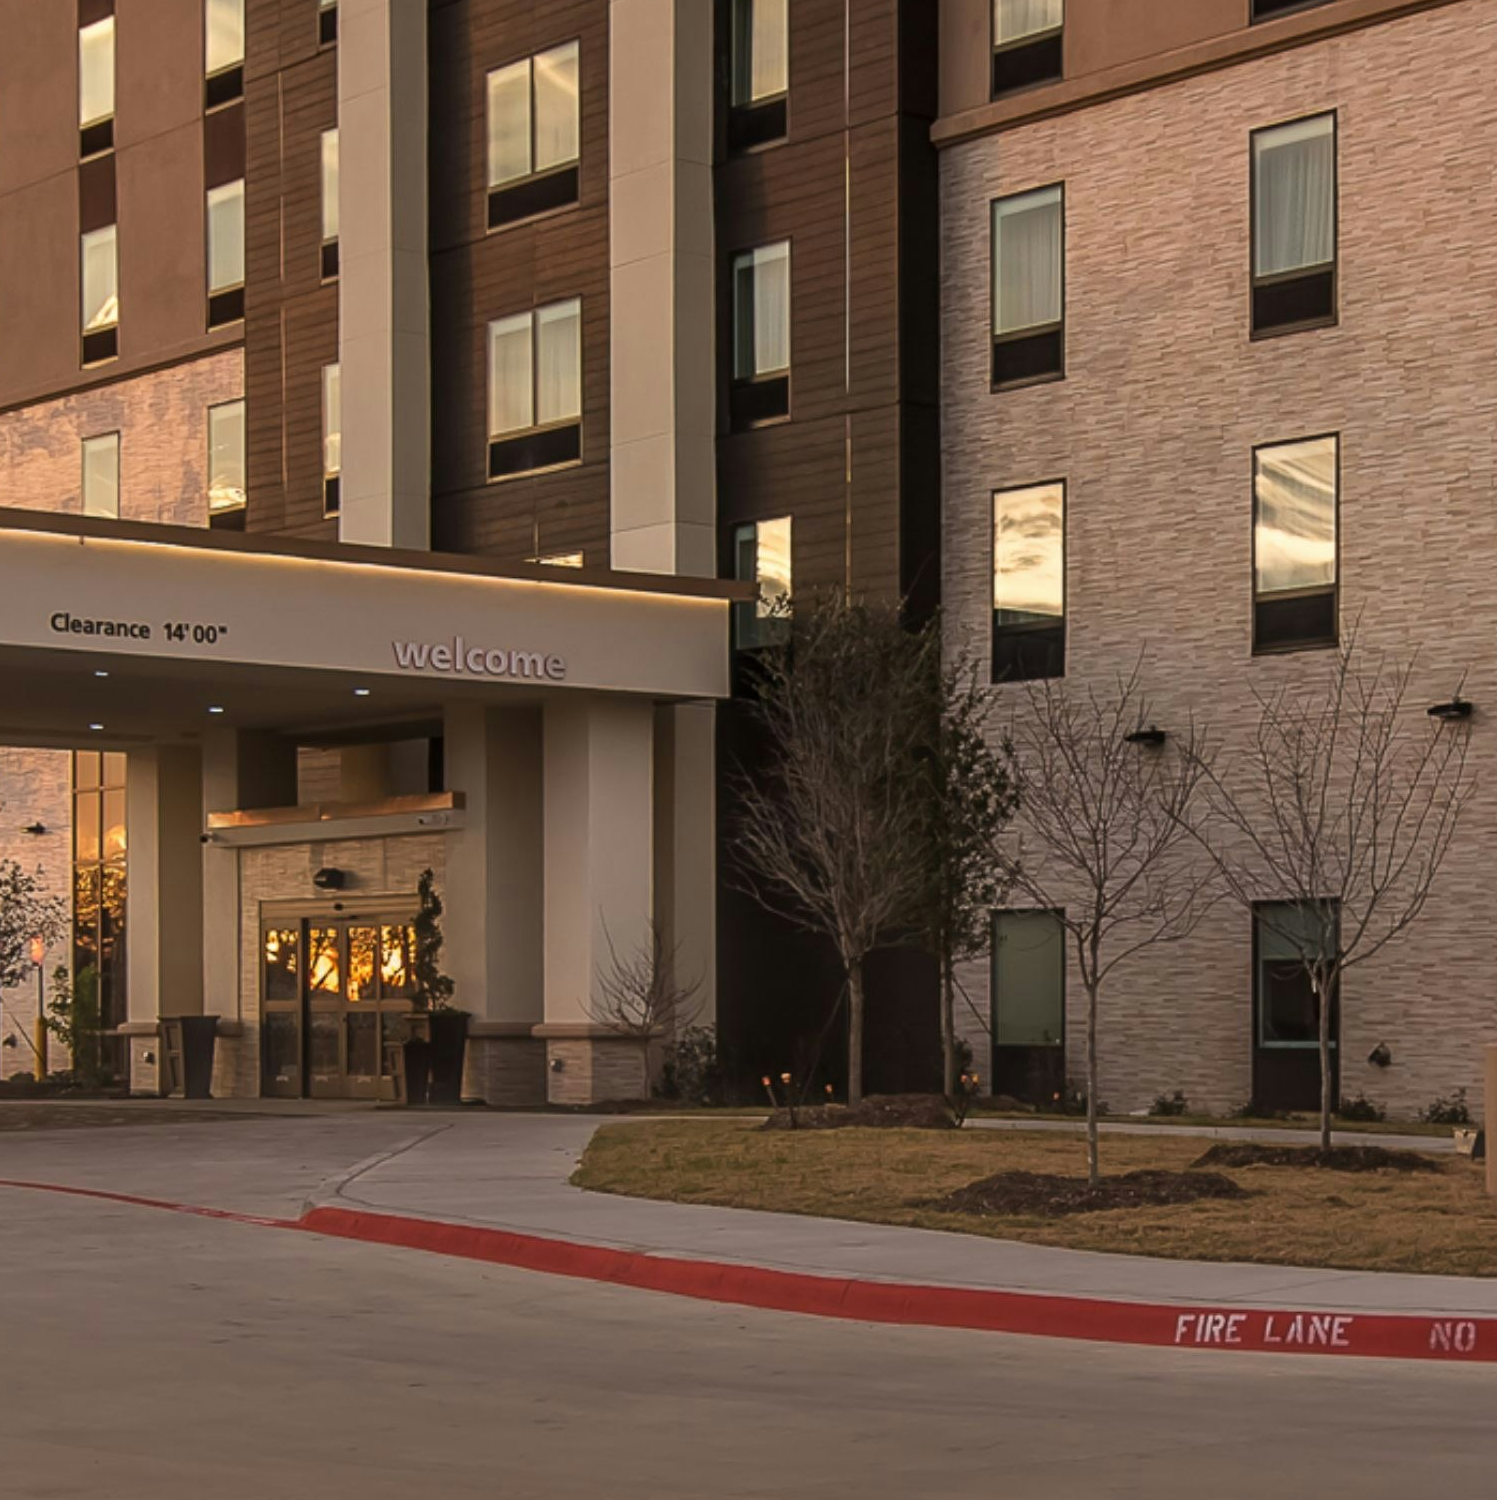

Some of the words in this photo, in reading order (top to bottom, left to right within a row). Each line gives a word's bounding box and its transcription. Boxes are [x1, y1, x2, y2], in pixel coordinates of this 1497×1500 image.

[51, 612, 151, 640] Clearance
[391, 635, 567, 680] welcome
[1174, 1313, 1247, 1344] FIRE
[1263, 1315, 1353, 1348] LANE
[1429, 1321, 1476, 1353] NO
